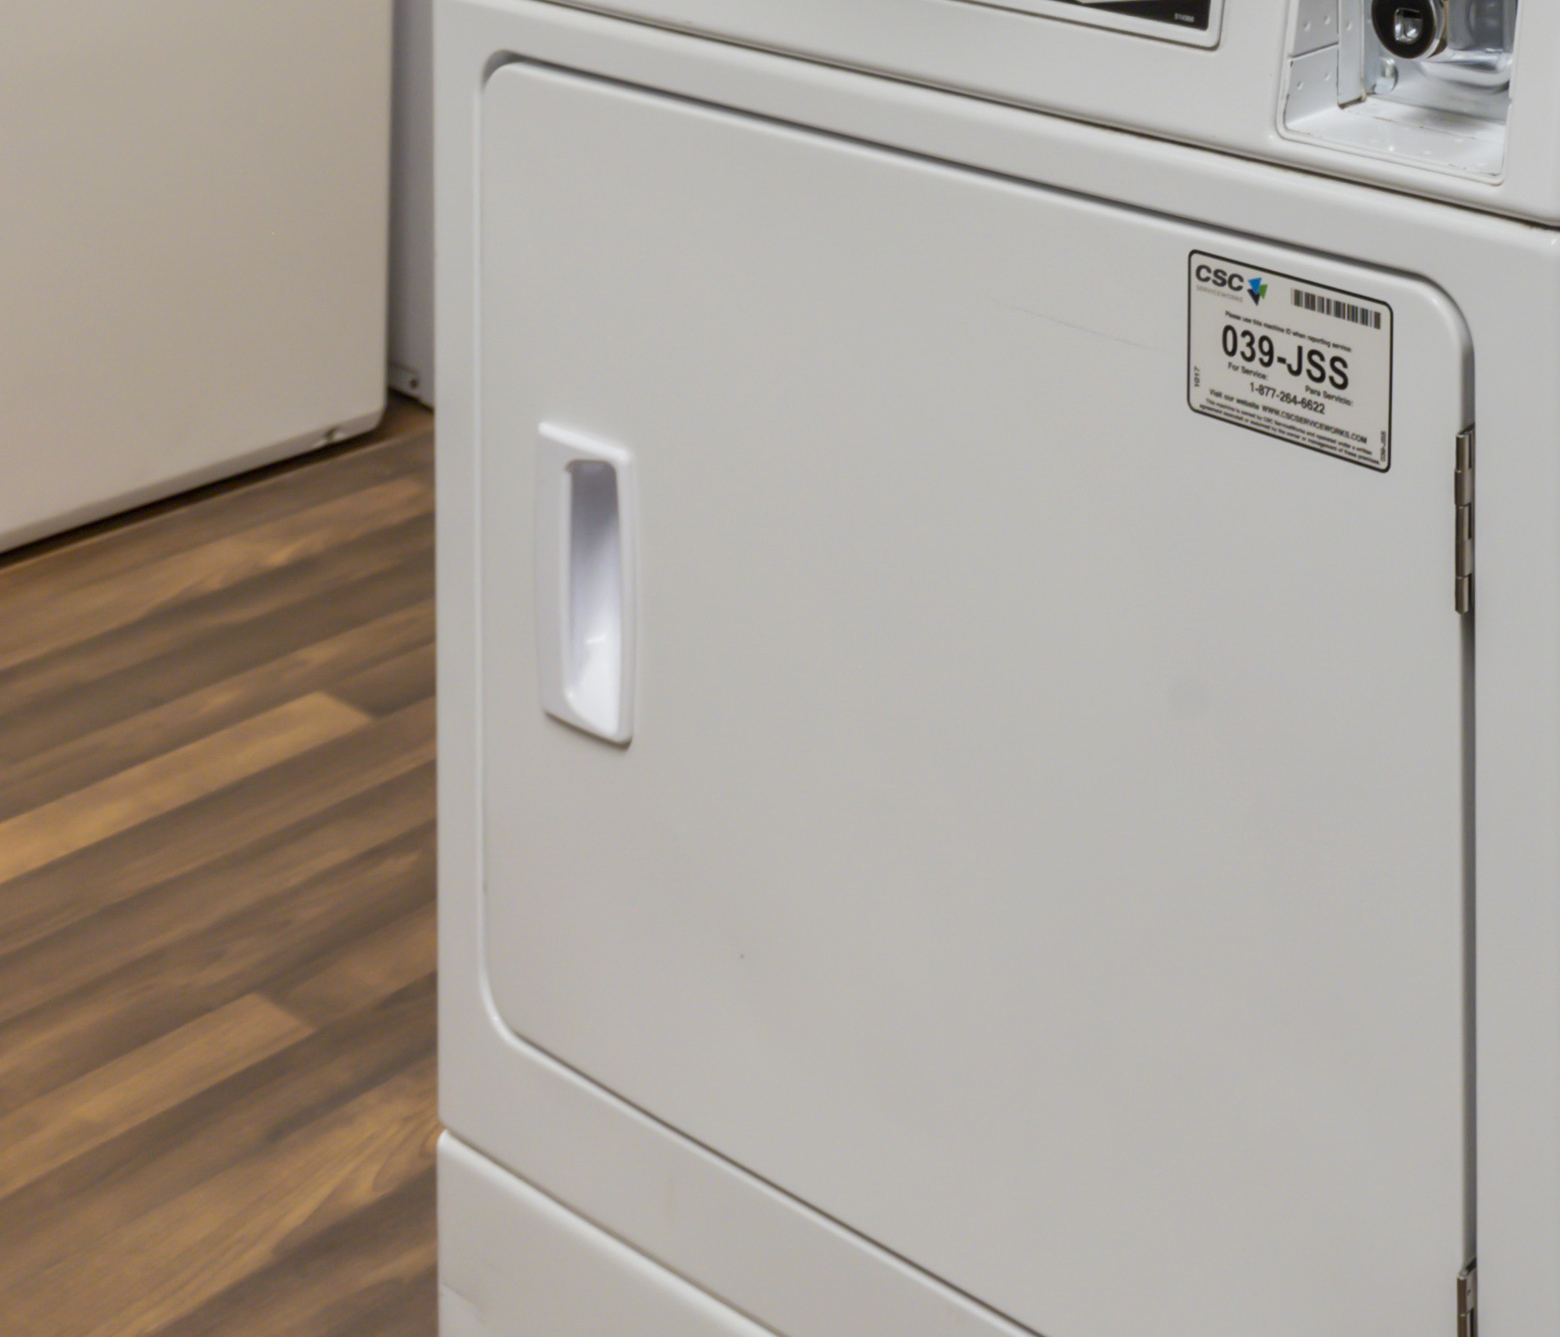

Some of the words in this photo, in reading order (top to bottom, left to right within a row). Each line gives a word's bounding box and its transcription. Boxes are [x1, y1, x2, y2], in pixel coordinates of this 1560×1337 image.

[1195, 264, 1244, 292] CSC
[1222, 324, 1349, 390] 039-JSS
[1249, 382, 1325, 414] 1-877-264-6622
